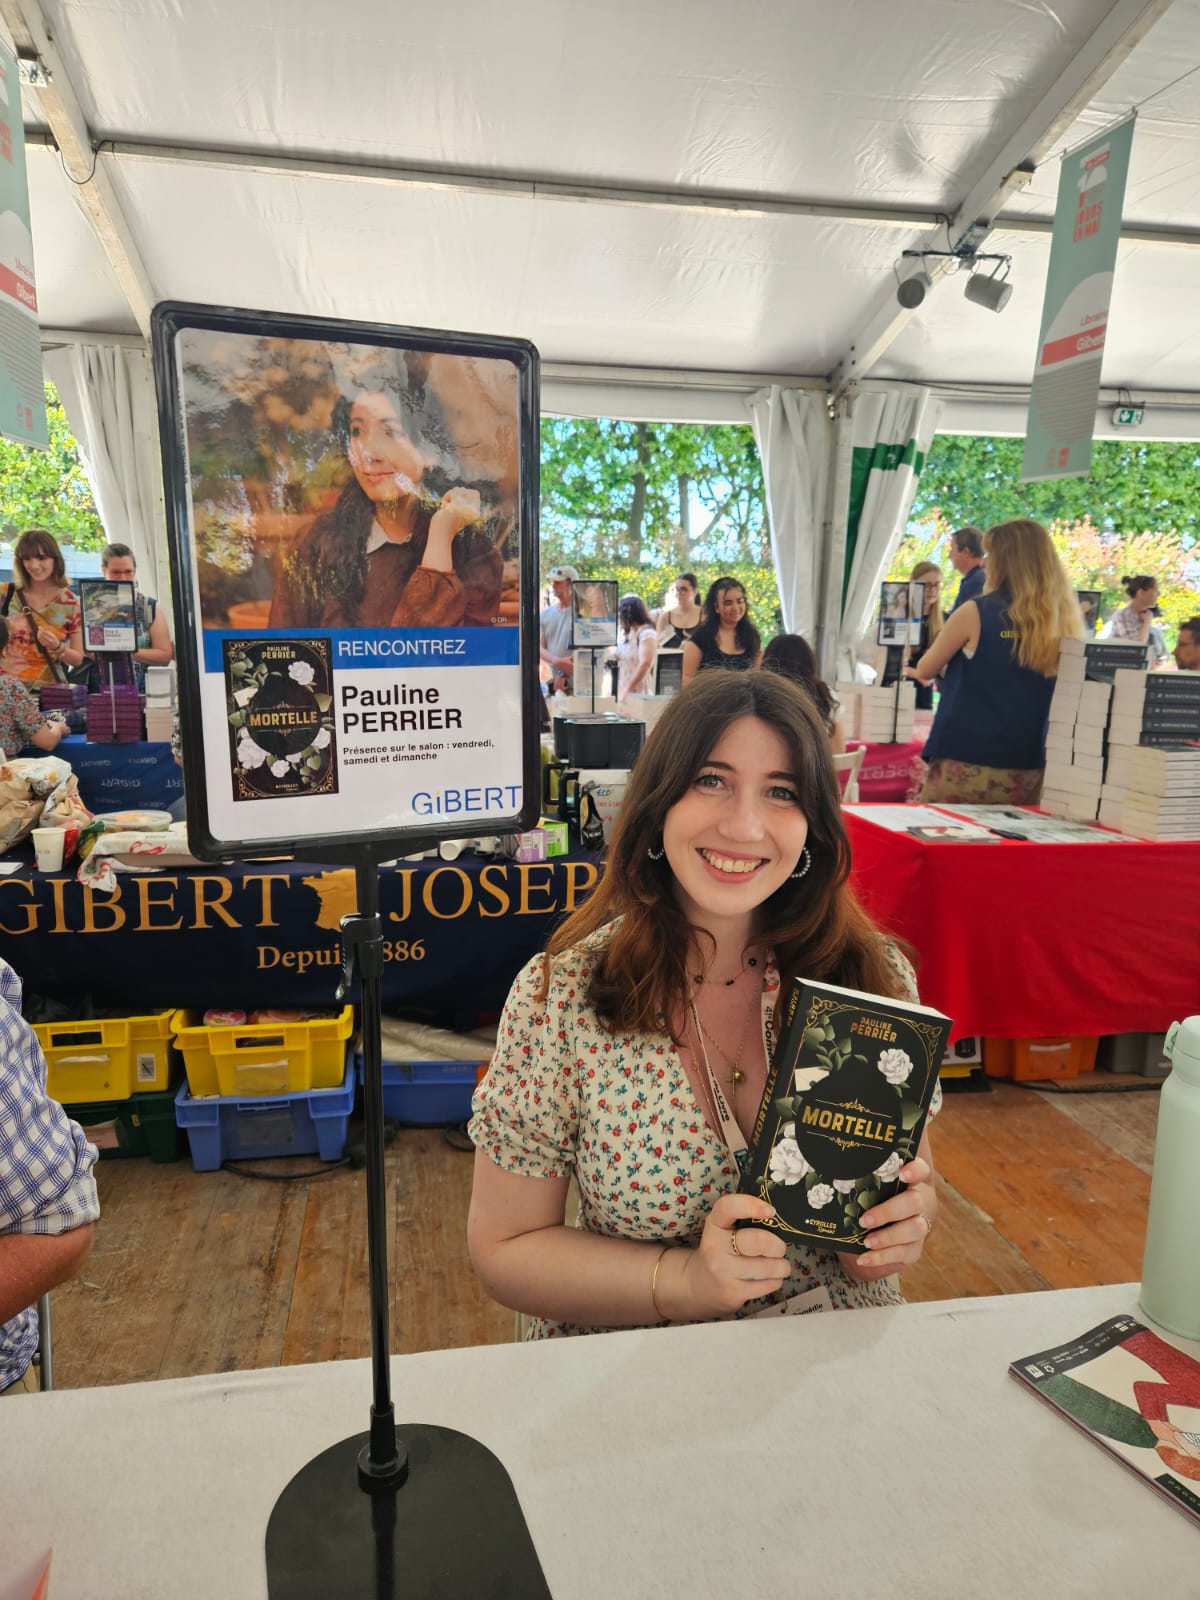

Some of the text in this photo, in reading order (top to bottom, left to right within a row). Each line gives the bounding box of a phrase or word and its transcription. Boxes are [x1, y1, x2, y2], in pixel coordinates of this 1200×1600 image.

[261, 650, 297, 660] PERRIER
[338, 639, 466, 656] RENCONTREZ
[341, 684, 440, 707] Pauline
[249, 711, 318, 727] MORTELLE
[343, 708, 463, 734] PERRIER
[343, 745, 388, 755] Présence
[390, 744, 405, 752] sur
[408, 743, 417, 751] le
[419, 741, 444, 751] salon
[452, 739, 495, 749] vendredi,
[343, 752, 438, 765] samedi et dimanche
[0, 861, 609, 935] GIBERT JOSEP
[256, 938, 427, 974] Depui 886
[850, 1022, 898, 1043] PERRIER
[860, 1016, 893, 1031] PAULINE
[717, 1095, 730, 1121] Livre
[753, 1068, 780, 1147] MORTELLE
[801, 1105, 897, 1144] MORTELLE
[809, 1218, 837, 1230] EYROLLES
